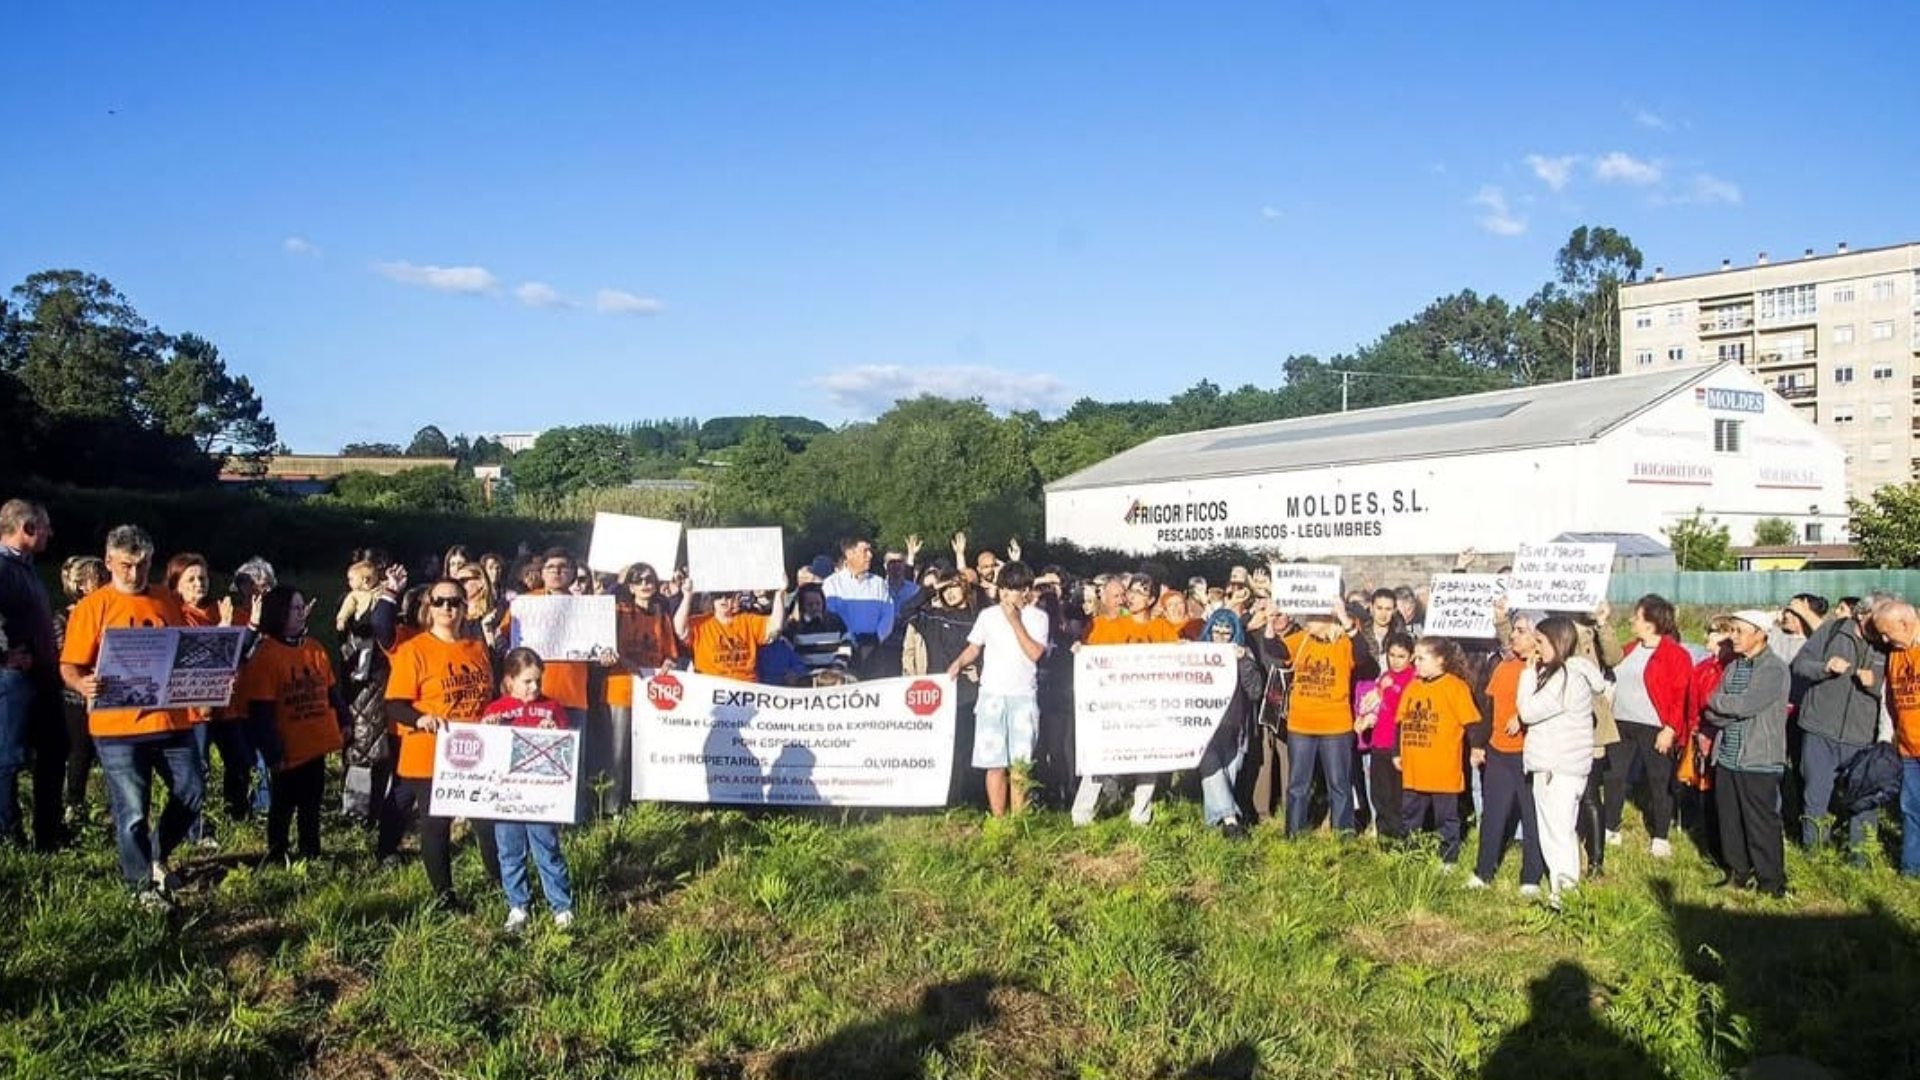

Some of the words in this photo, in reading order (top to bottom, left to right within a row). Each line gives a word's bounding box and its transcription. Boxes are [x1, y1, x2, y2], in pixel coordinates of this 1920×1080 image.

[1708, 389, 1764, 412] MOLDES
[1392, 488, 1429, 513] S.L.
[1157, 526, 1214, 542] PESCADOS
[1224, 524, 1287, 540] MARISCOS
[1298, 520, 1382, 539] LEGUMBRES
[1291, 584, 1317, 592] PARA
[650, 684, 682, 700] STOP
[907, 689, 940, 706] STOP
[711, 689, 880, 710] EXPROPIACIÓN
[827, 722, 843, 731] DA
[451, 738, 480, 755] STOP
